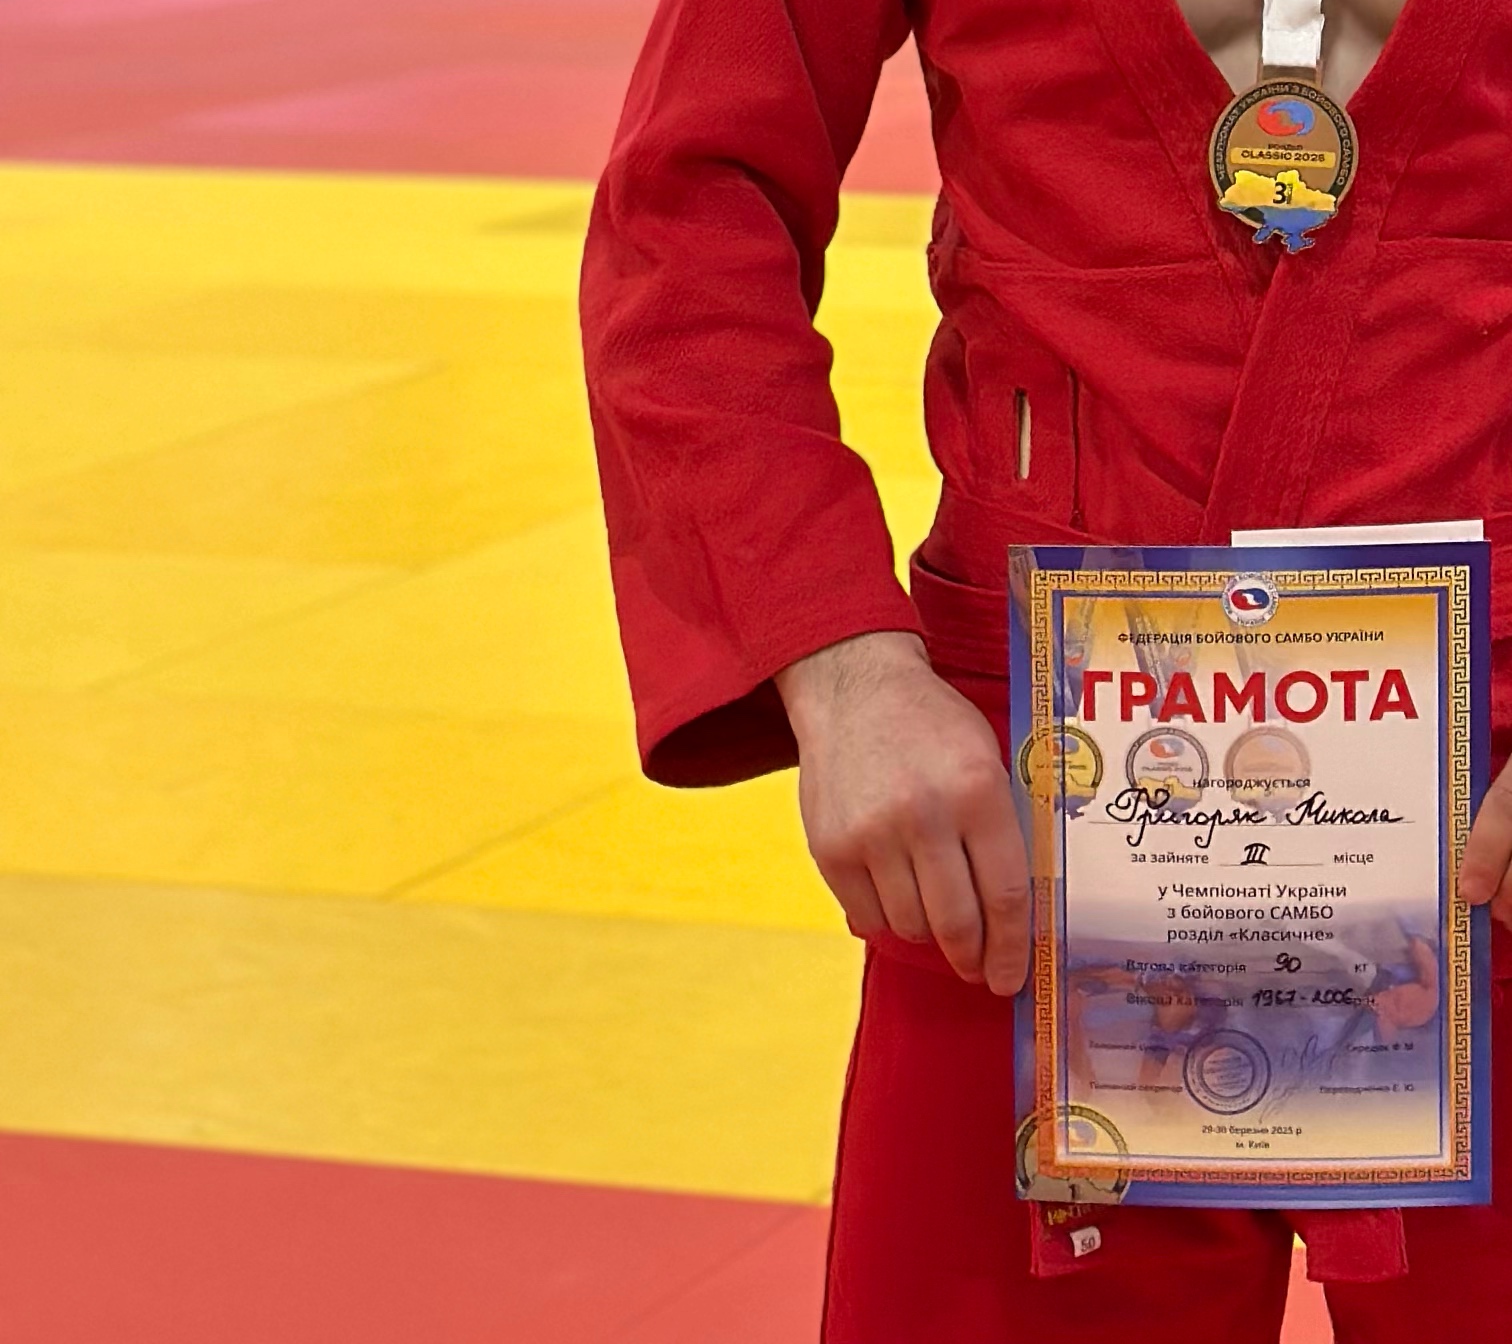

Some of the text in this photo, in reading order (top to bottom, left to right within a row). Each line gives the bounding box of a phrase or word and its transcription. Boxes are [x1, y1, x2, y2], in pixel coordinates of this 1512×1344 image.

[1241, 150, 1292, 161] CLASSIC
[1273, 181, 1287, 205] 3
[1117, 630, 1384, 646] ФЕДЕРАЦІЯ БОЙОВОГО САМБО УКРАЇНИ
[1082, 669, 1419, 724] ГРАМОТА
[1193, 778, 1311, 791] нагороджується
[1286, 791, 1405, 826] Микола
[1131, 851, 1209, 864] за зайняте
[1333, 852, 1374, 865] місце
[1158, 884, 1347, 901] у Чемпіонаті України
[1167, 905, 1334, 920] з бойового САМБО
[1167, 926, 1334, 944] розділ «Класичне»
[1179, 961, 1248, 975] категорія
[1274, 952, 1302, 973] 90
[1354, 963, 1367, 973] кг
[1081, 1236, 1096, 1252] 50
